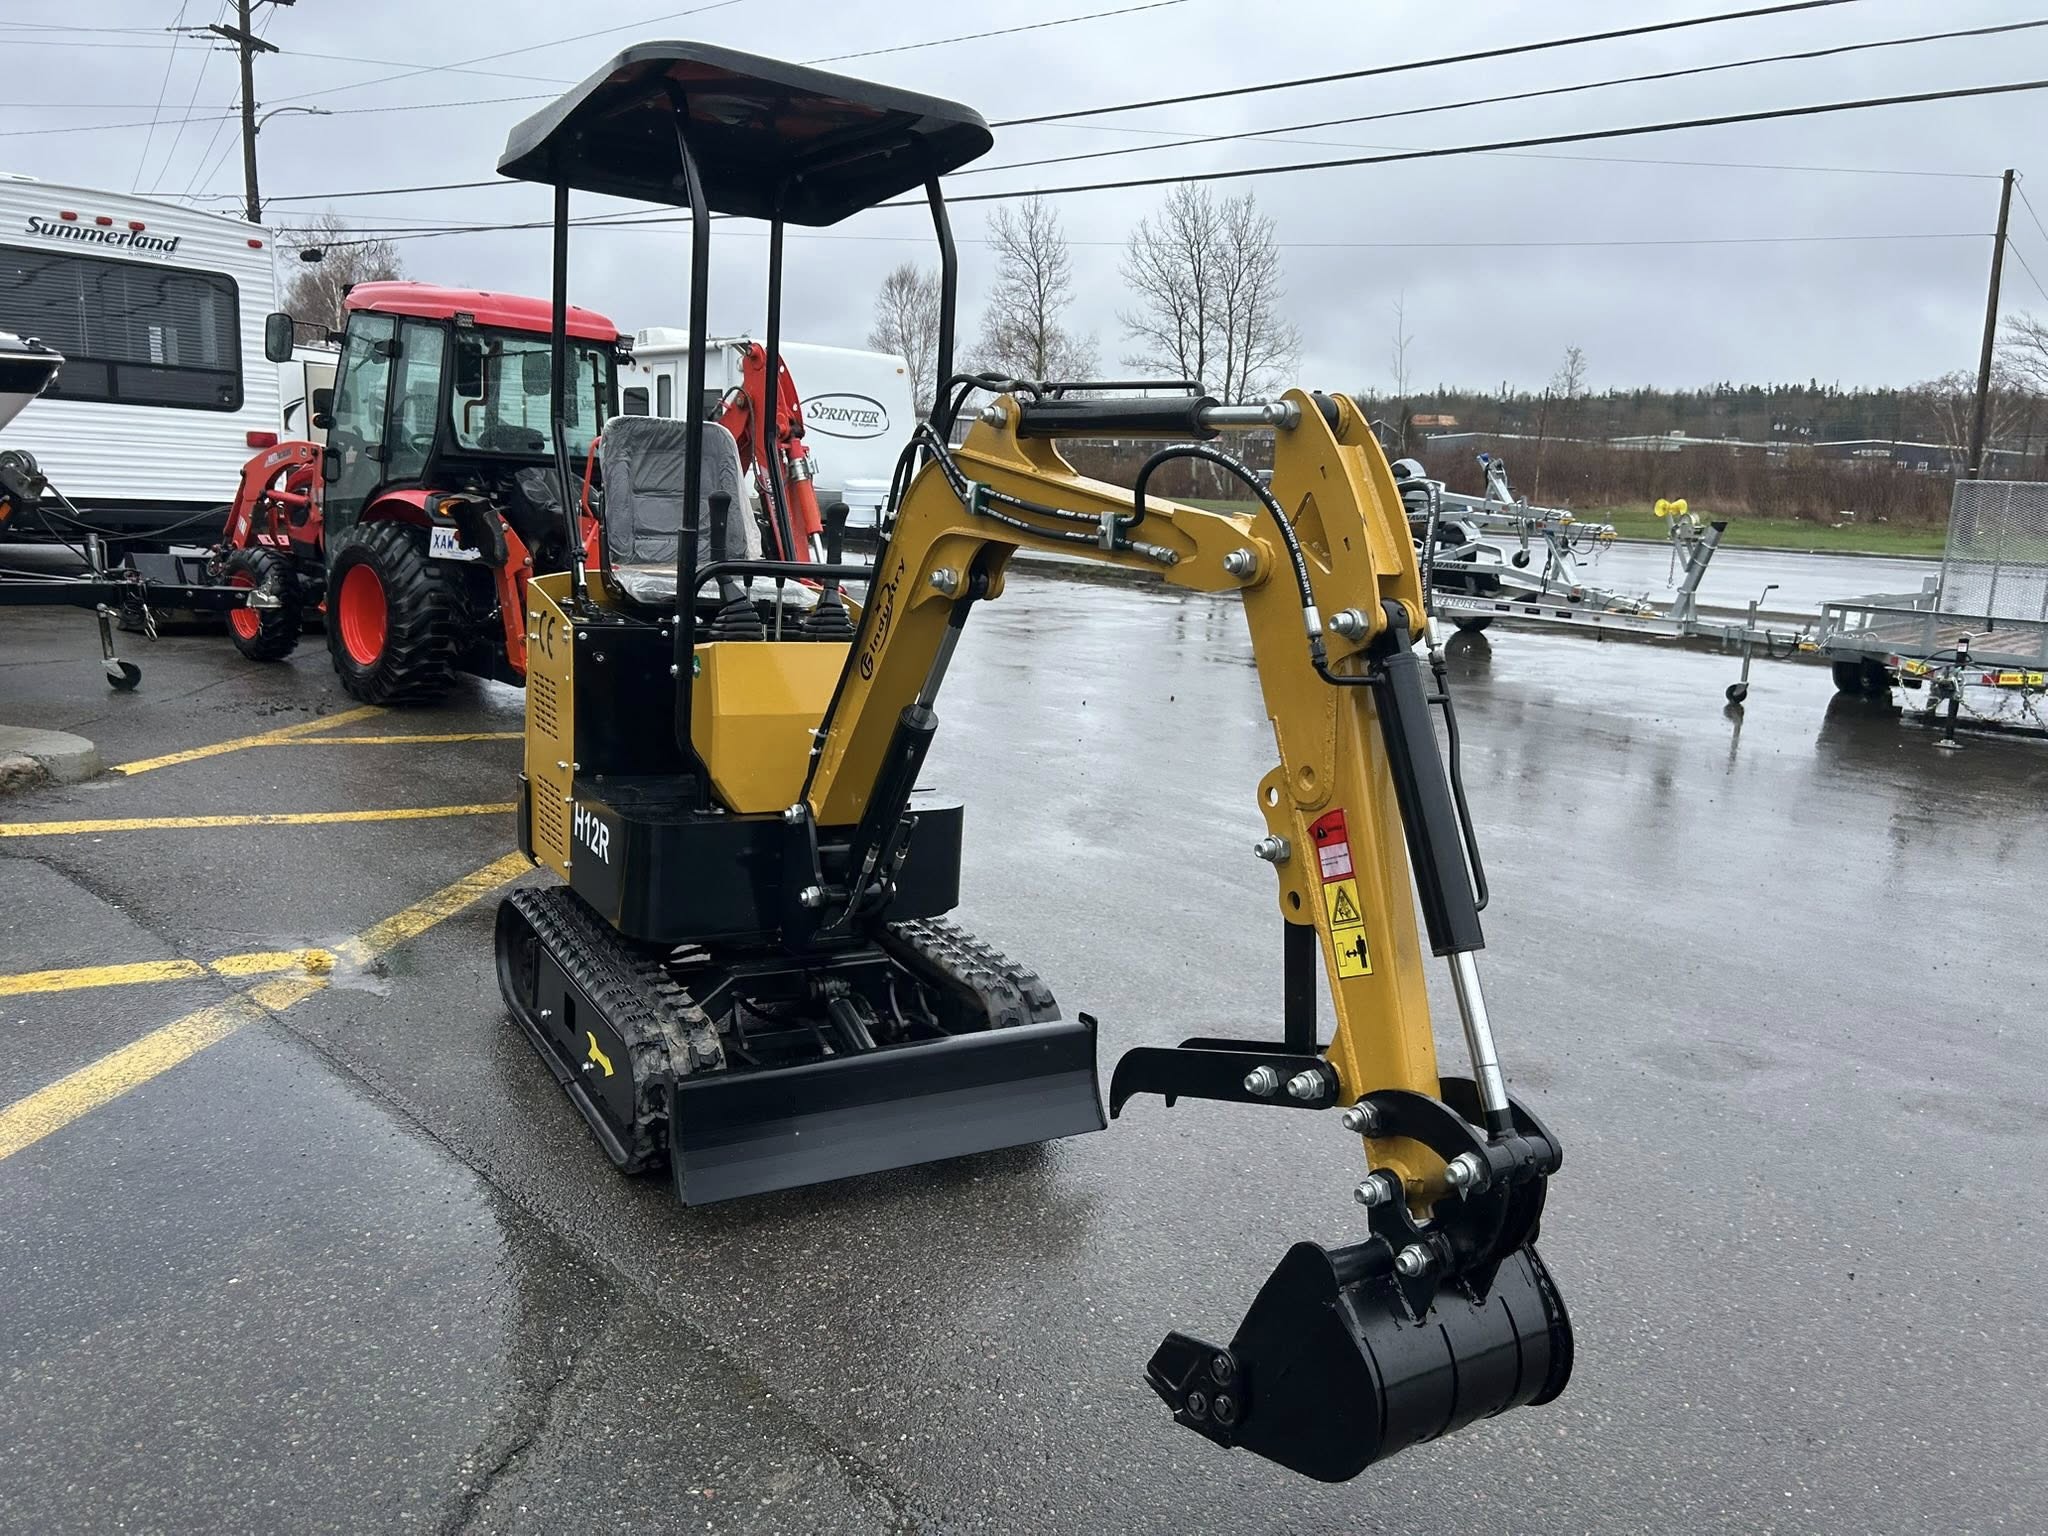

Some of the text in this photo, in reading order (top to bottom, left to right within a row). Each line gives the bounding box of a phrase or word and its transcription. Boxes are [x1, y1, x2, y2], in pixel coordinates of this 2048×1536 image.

[25, 216, 182, 253] Summerland
[807, 401, 879, 424] SPRINTER
[1434, 597, 1477, 609] VENTURE
[539, 610, 555, 660] CE
[574, 801, 610, 864] H12R
